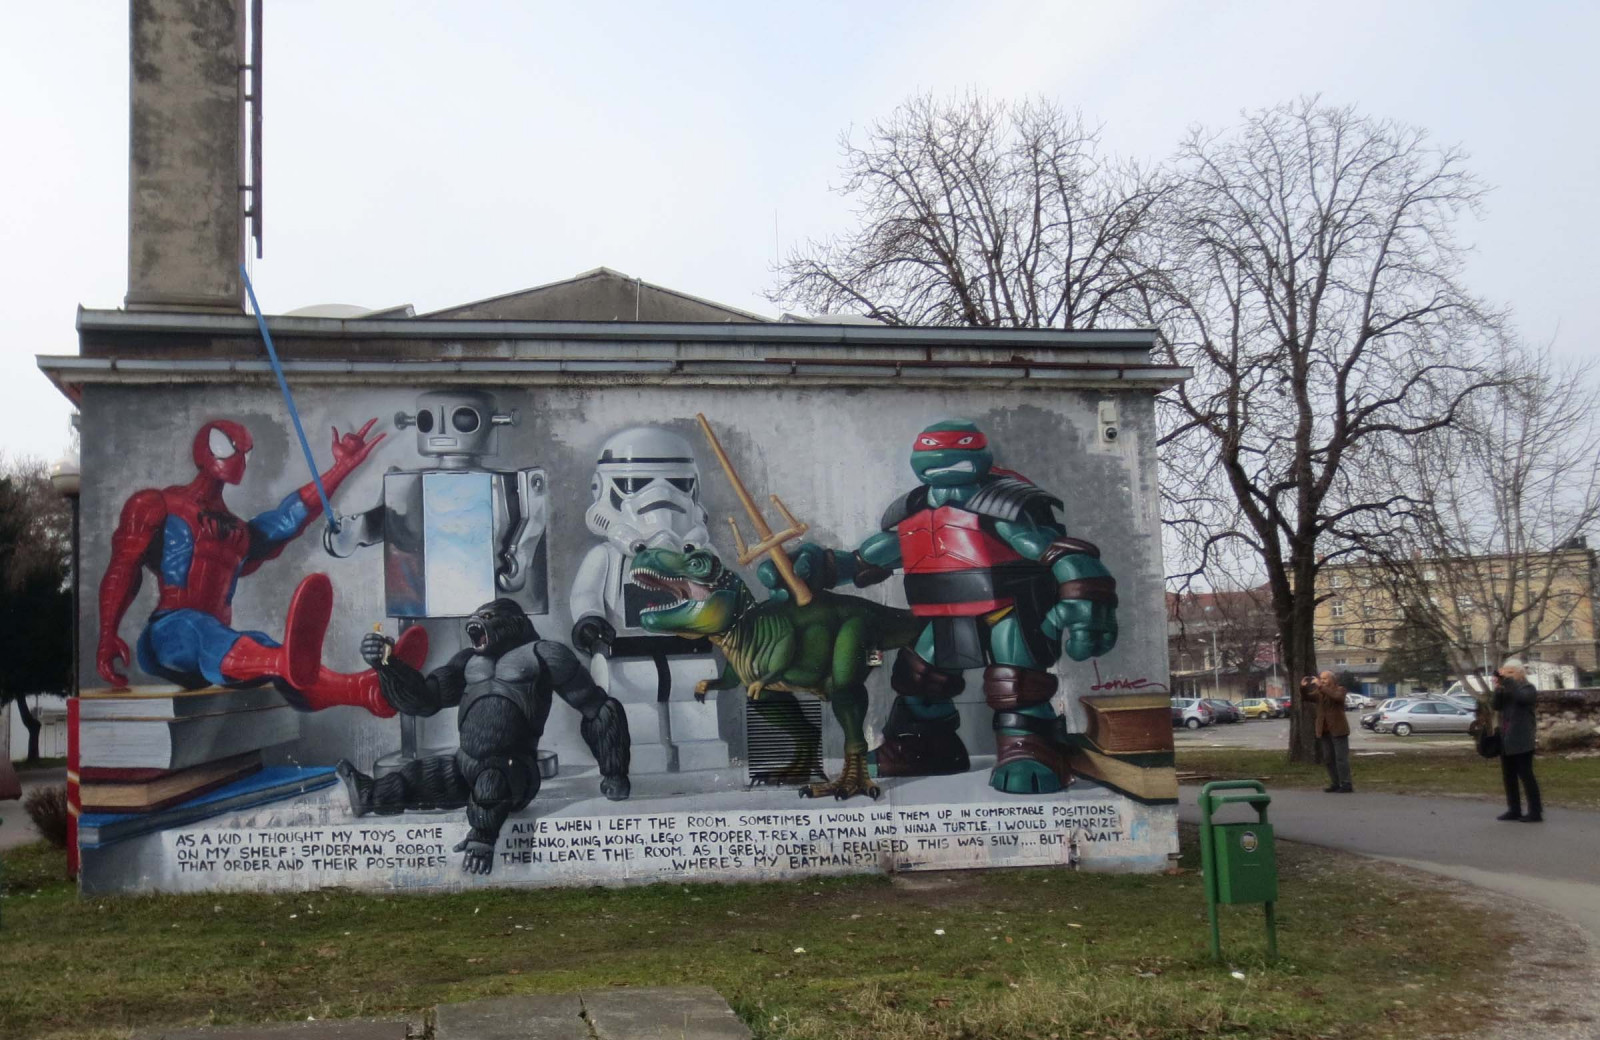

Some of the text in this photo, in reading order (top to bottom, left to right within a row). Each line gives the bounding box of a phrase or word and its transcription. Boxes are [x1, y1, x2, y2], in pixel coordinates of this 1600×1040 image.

[175, 834, 196, 846] AS
[200, 834, 212, 845] A
[218, 833, 242, 845] KID
[248, 833, 252, 843] I
[260, 831, 324, 844] THOUGHT
[332, 831, 353, 843] MY
[360, 830, 396, 842] TOYS
[406, 828, 443, 840] CAME
[511, 821, 548, 833] ALIVE
[555, 820, 592, 832] WHEN
[597, 820, 601, 831] I
[609, 819, 642, 831] LEFT
[648, 817, 676, 829] THE
[687, 816, 730, 828] ROOM.
[739, 815, 811, 826] SOMETIMES
[819, 814, 823, 824] I
[827, 813, 865, 823] WOULD
[898, 811, 930, 821] THEM
[937, 810, 953, 819] UP
[960, 809, 971, 818] IN
[975, 806, 1044, 817] COMFORTABLE
[1052, 805, 1116, 817] POSITIONS
[177, 849, 199, 861] ON
[206, 847, 230, 859] MY
[571, 836, 601, 847] KING
[651, 833, 684, 846] LEGO
[809, 827, 867, 841] BATMAN
[874, 825, 898, 835] AND
[904, 823, 937, 834] NINJA
[997, 820, 1001, 830] I
[1004, 819, 1047, 831] WOULD
[1055, 817, 1117, 828] MEMORIZE
[178, 861, 217, 872] THAT
[223, 859, 272, 871] ORDER
[277, 859, 304, 871] AND
[312, 858, 358, 870] THEIR
[366, 856, 447, 870] POSTURES
[500, 851, 543, 864] THEN
[549, 849, 595, 863] LEAVE
[602, 848, 635, 862] THE
[644, 847, 686, 858] ROOM.
[692, 845, 711, 856] AS
[719, 844, 722, 855] I
[775, 844, 816, 856] OLDER
[830, 842, 834, 852] I
[843, 840, 909, 853] REALISED
[918, 838, 950, 850] THIS
[958, 836, 985, 847] WAS
[754, 855, 778, 867] MY
